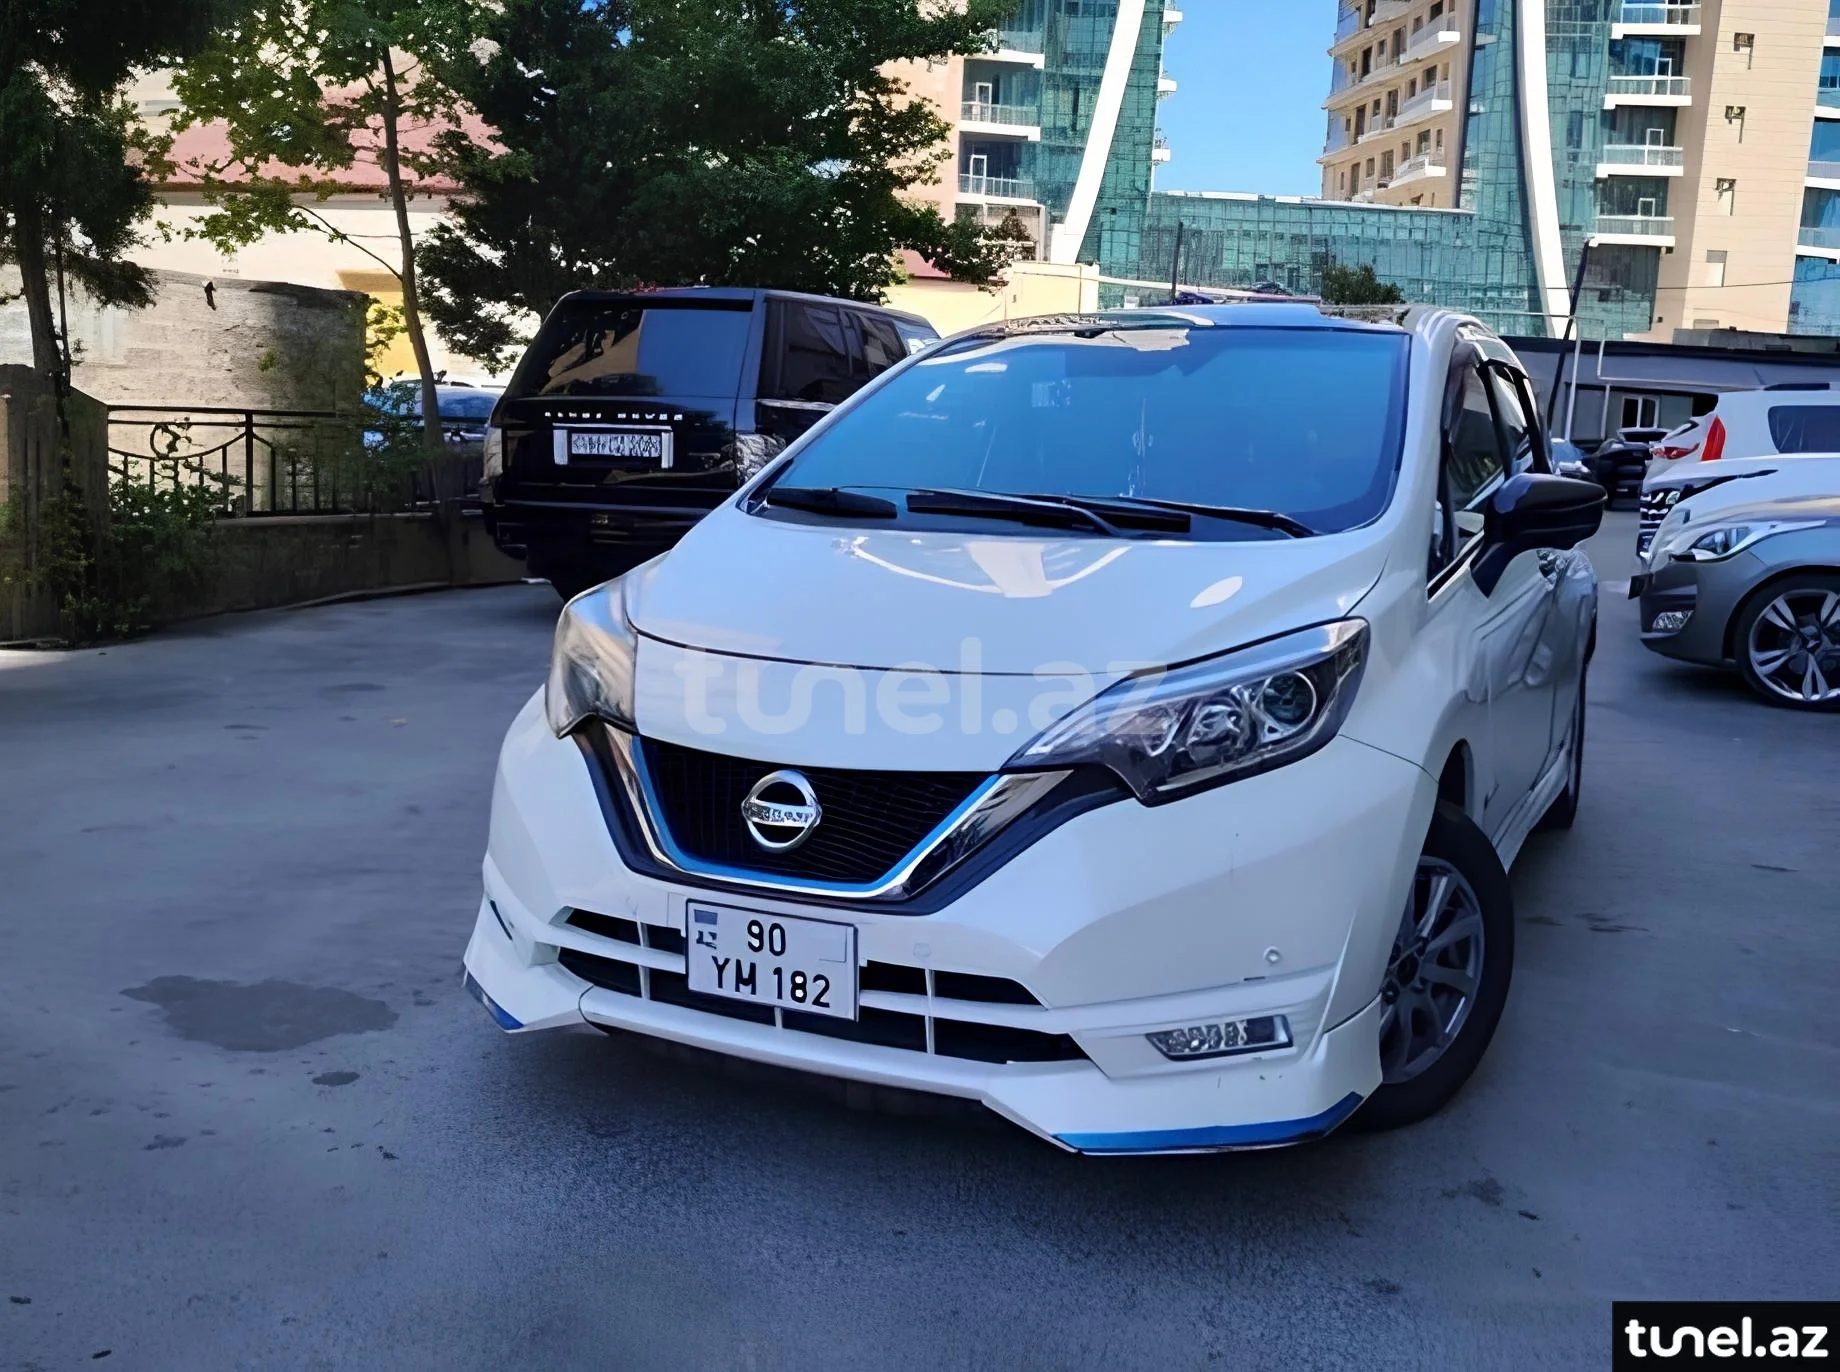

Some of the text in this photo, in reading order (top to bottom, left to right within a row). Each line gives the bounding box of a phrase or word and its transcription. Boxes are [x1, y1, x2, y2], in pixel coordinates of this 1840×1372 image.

[747, 919, 787, 957] 90
[711, 955, 830, 1009] YM 182
